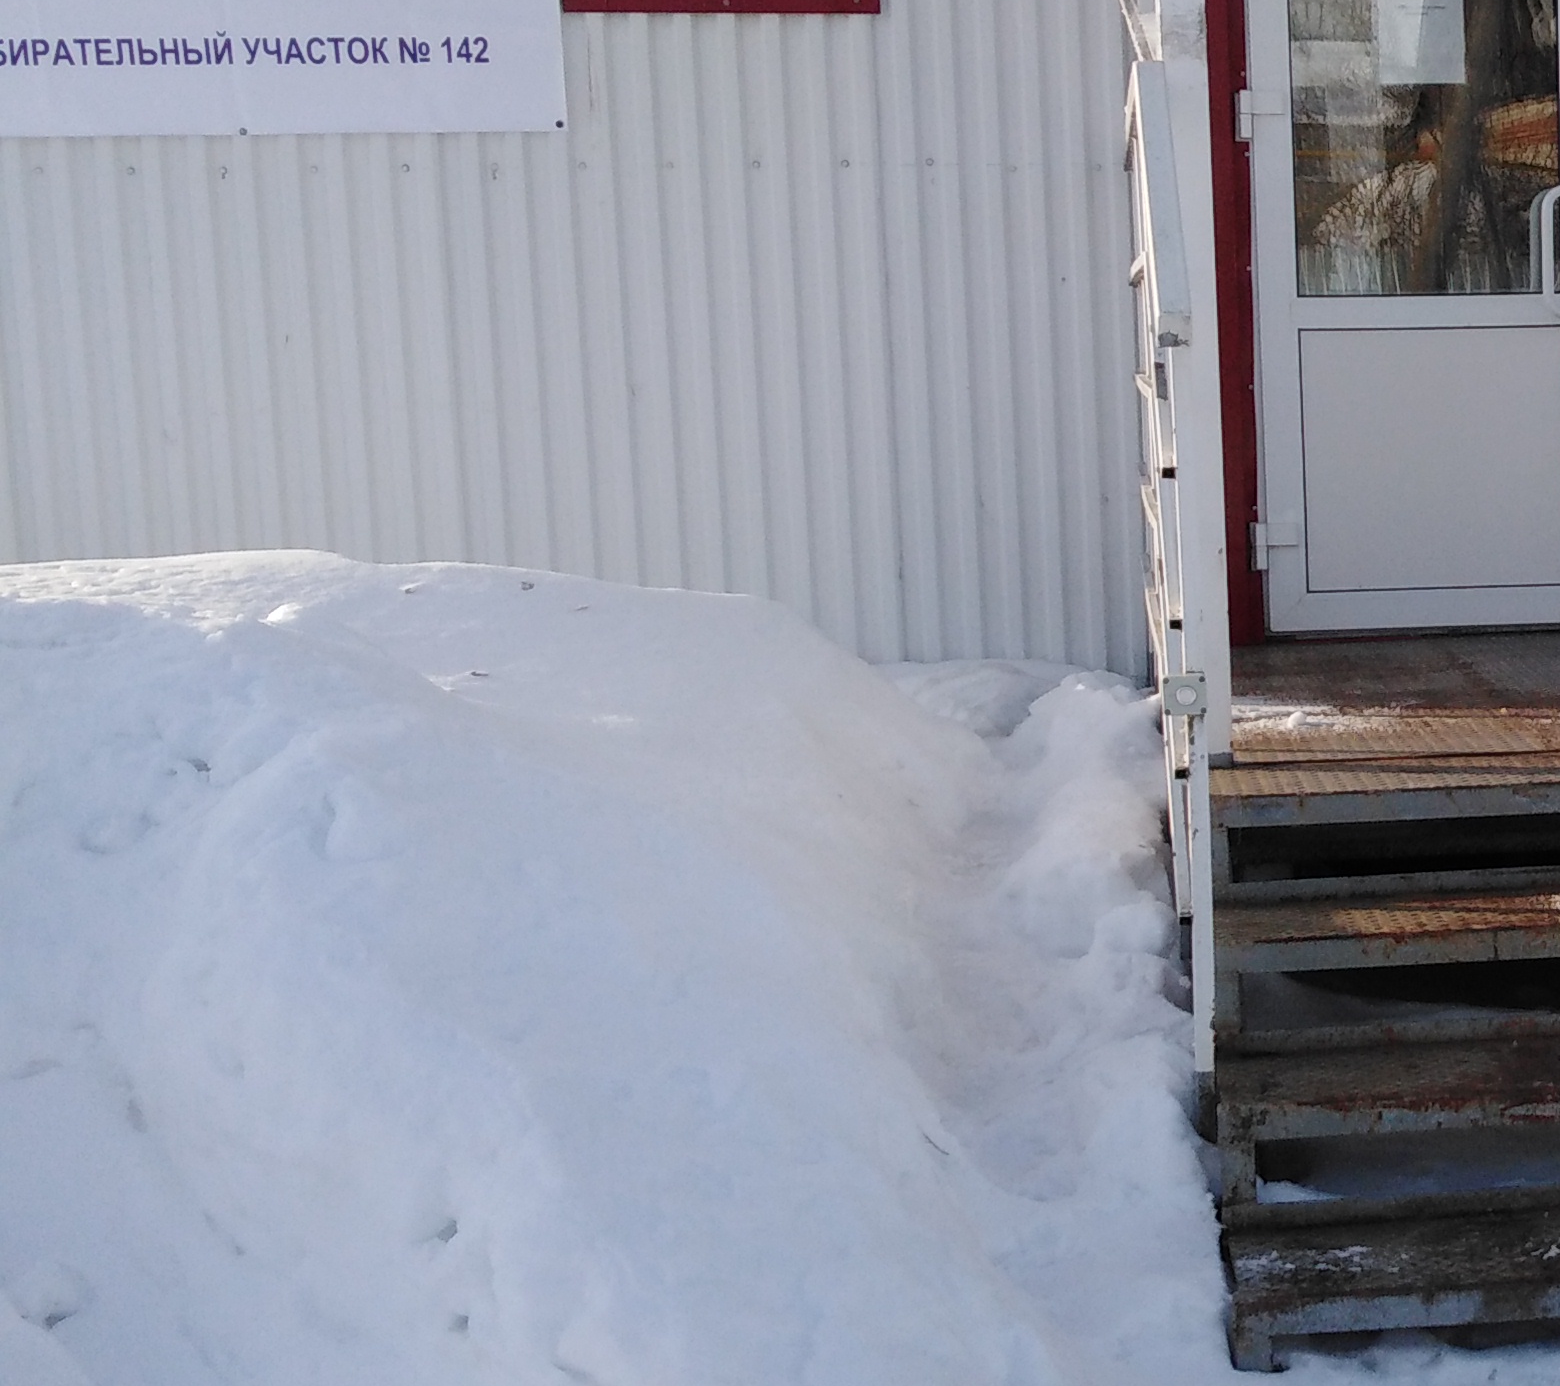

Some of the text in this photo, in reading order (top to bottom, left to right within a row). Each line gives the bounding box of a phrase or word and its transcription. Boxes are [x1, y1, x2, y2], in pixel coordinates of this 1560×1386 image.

[242, 36, 390, 65] УЧАСТОК
[398, 36, 431, 64] №
[440, 36, 490, 64] 142
